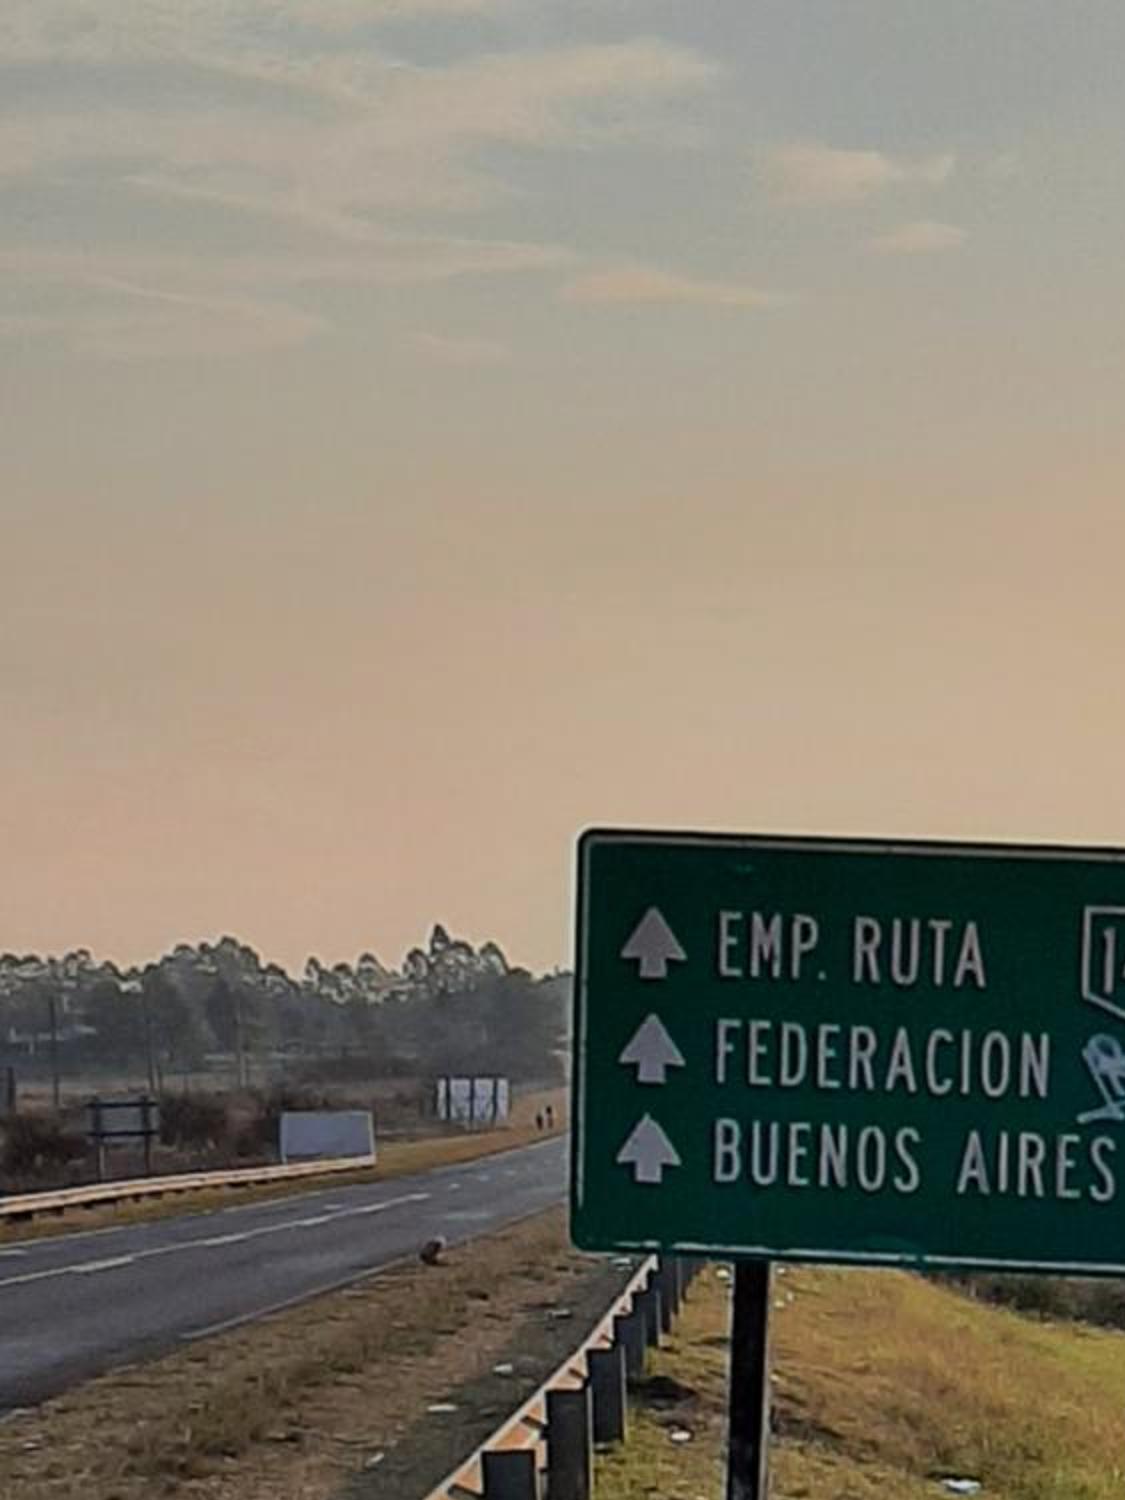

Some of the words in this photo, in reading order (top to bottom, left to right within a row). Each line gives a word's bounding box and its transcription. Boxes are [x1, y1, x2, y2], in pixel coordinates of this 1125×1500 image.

[718, 911, 827, 981] EMP.
[853, 916, 987, 988] RUTA
[714, 1018, 1050, 1097] FEDERACION
[713, 1117, 921, 1193] BUENOS
[956, 1131, 1116, 1202] AIRES
